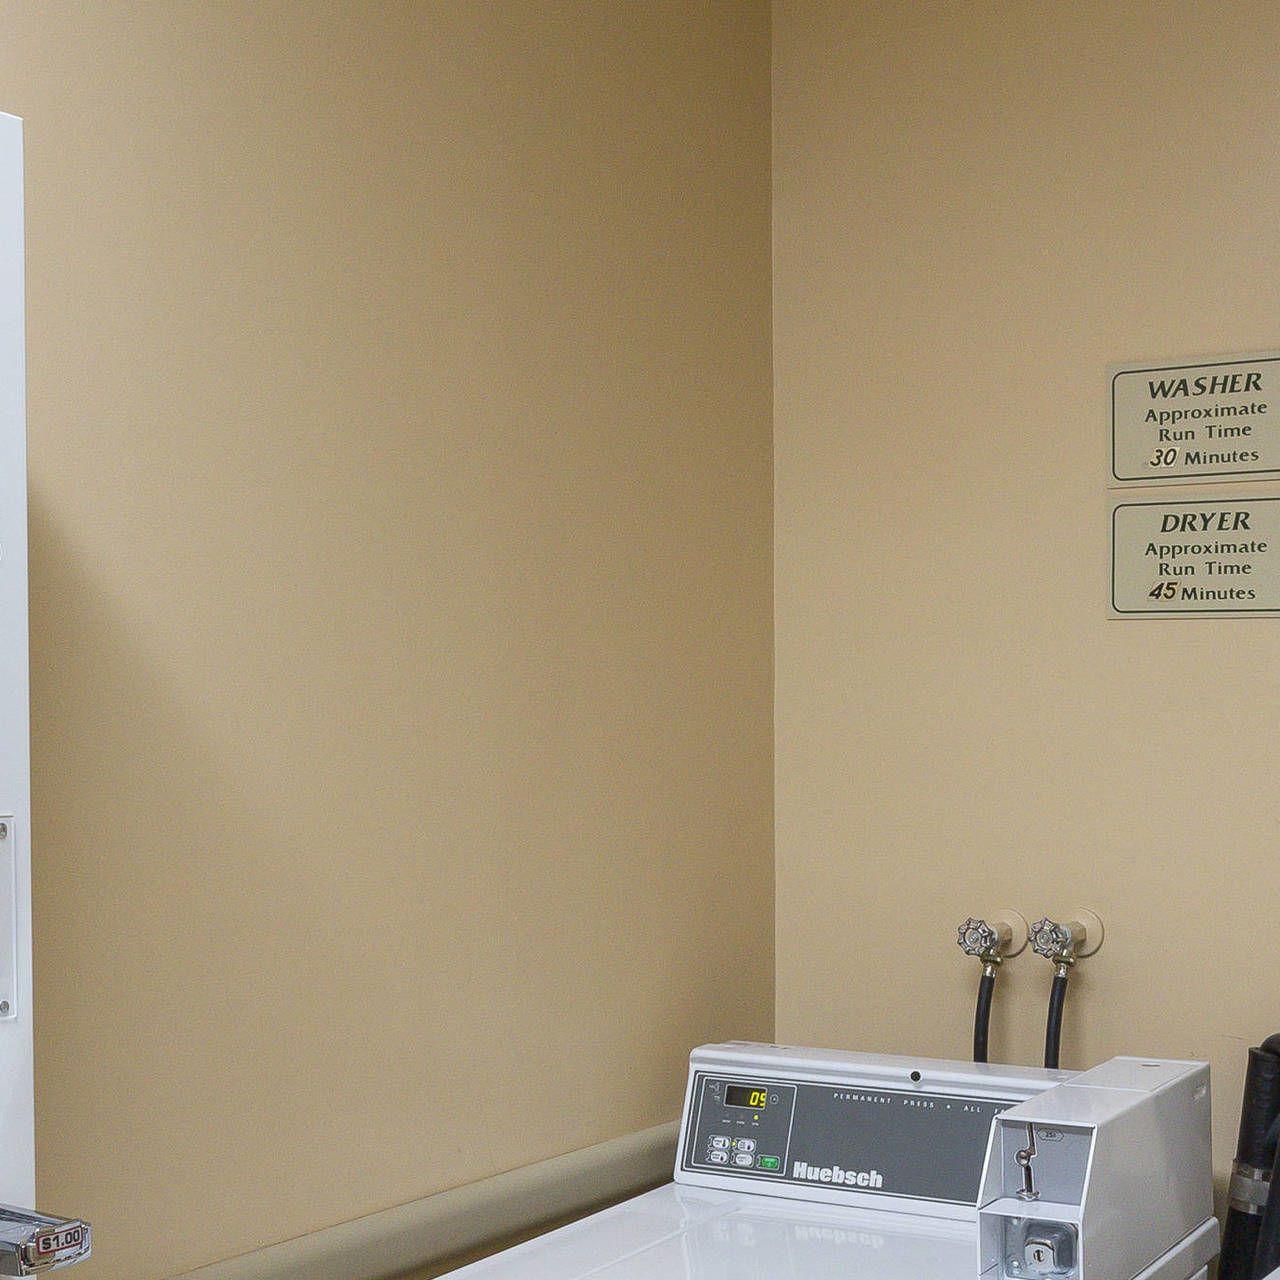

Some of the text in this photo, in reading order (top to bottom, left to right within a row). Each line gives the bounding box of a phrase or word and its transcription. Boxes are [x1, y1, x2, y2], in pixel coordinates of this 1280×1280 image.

[1148, 372, 1263, 400] WASHER
[1144, 400, 1268, 426] Approximate
[1159, 424, 1253, 442] Run Time
[1149, 448, 1260, 467] 30 Minutes
[1160, 511, 1251, 533] DRYER
[1144, 540, 1268, 560] Approximate
[1158, 560, 1253, 576] Run Time
[1148, 581, 1256, 601] 45 Minutes
[792, 1161, 883, 1188] Huebsch
[41, 1228, 81, 1250] $1.00
